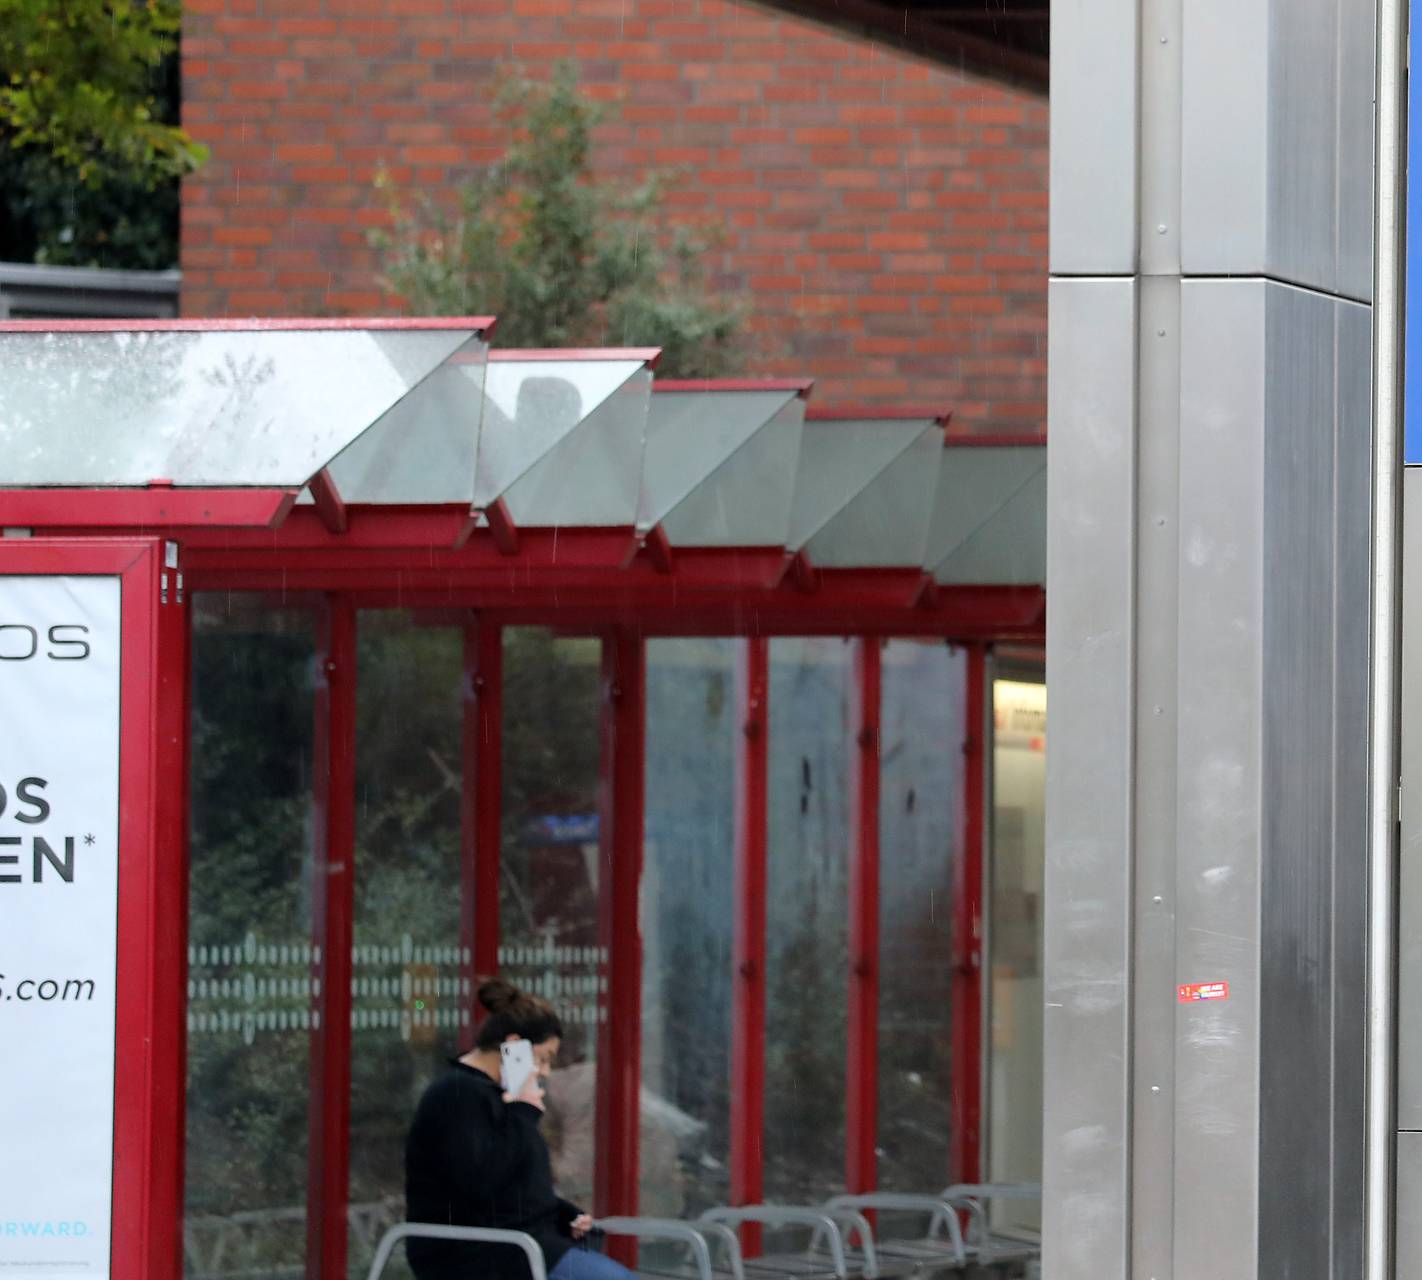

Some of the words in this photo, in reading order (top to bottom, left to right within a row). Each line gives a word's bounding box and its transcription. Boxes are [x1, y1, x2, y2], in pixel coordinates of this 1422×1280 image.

[0, 776, 50, 824] S
[0, 973, 95, 1001] .com
[0, 1221, 93, 1237] RWARD.
